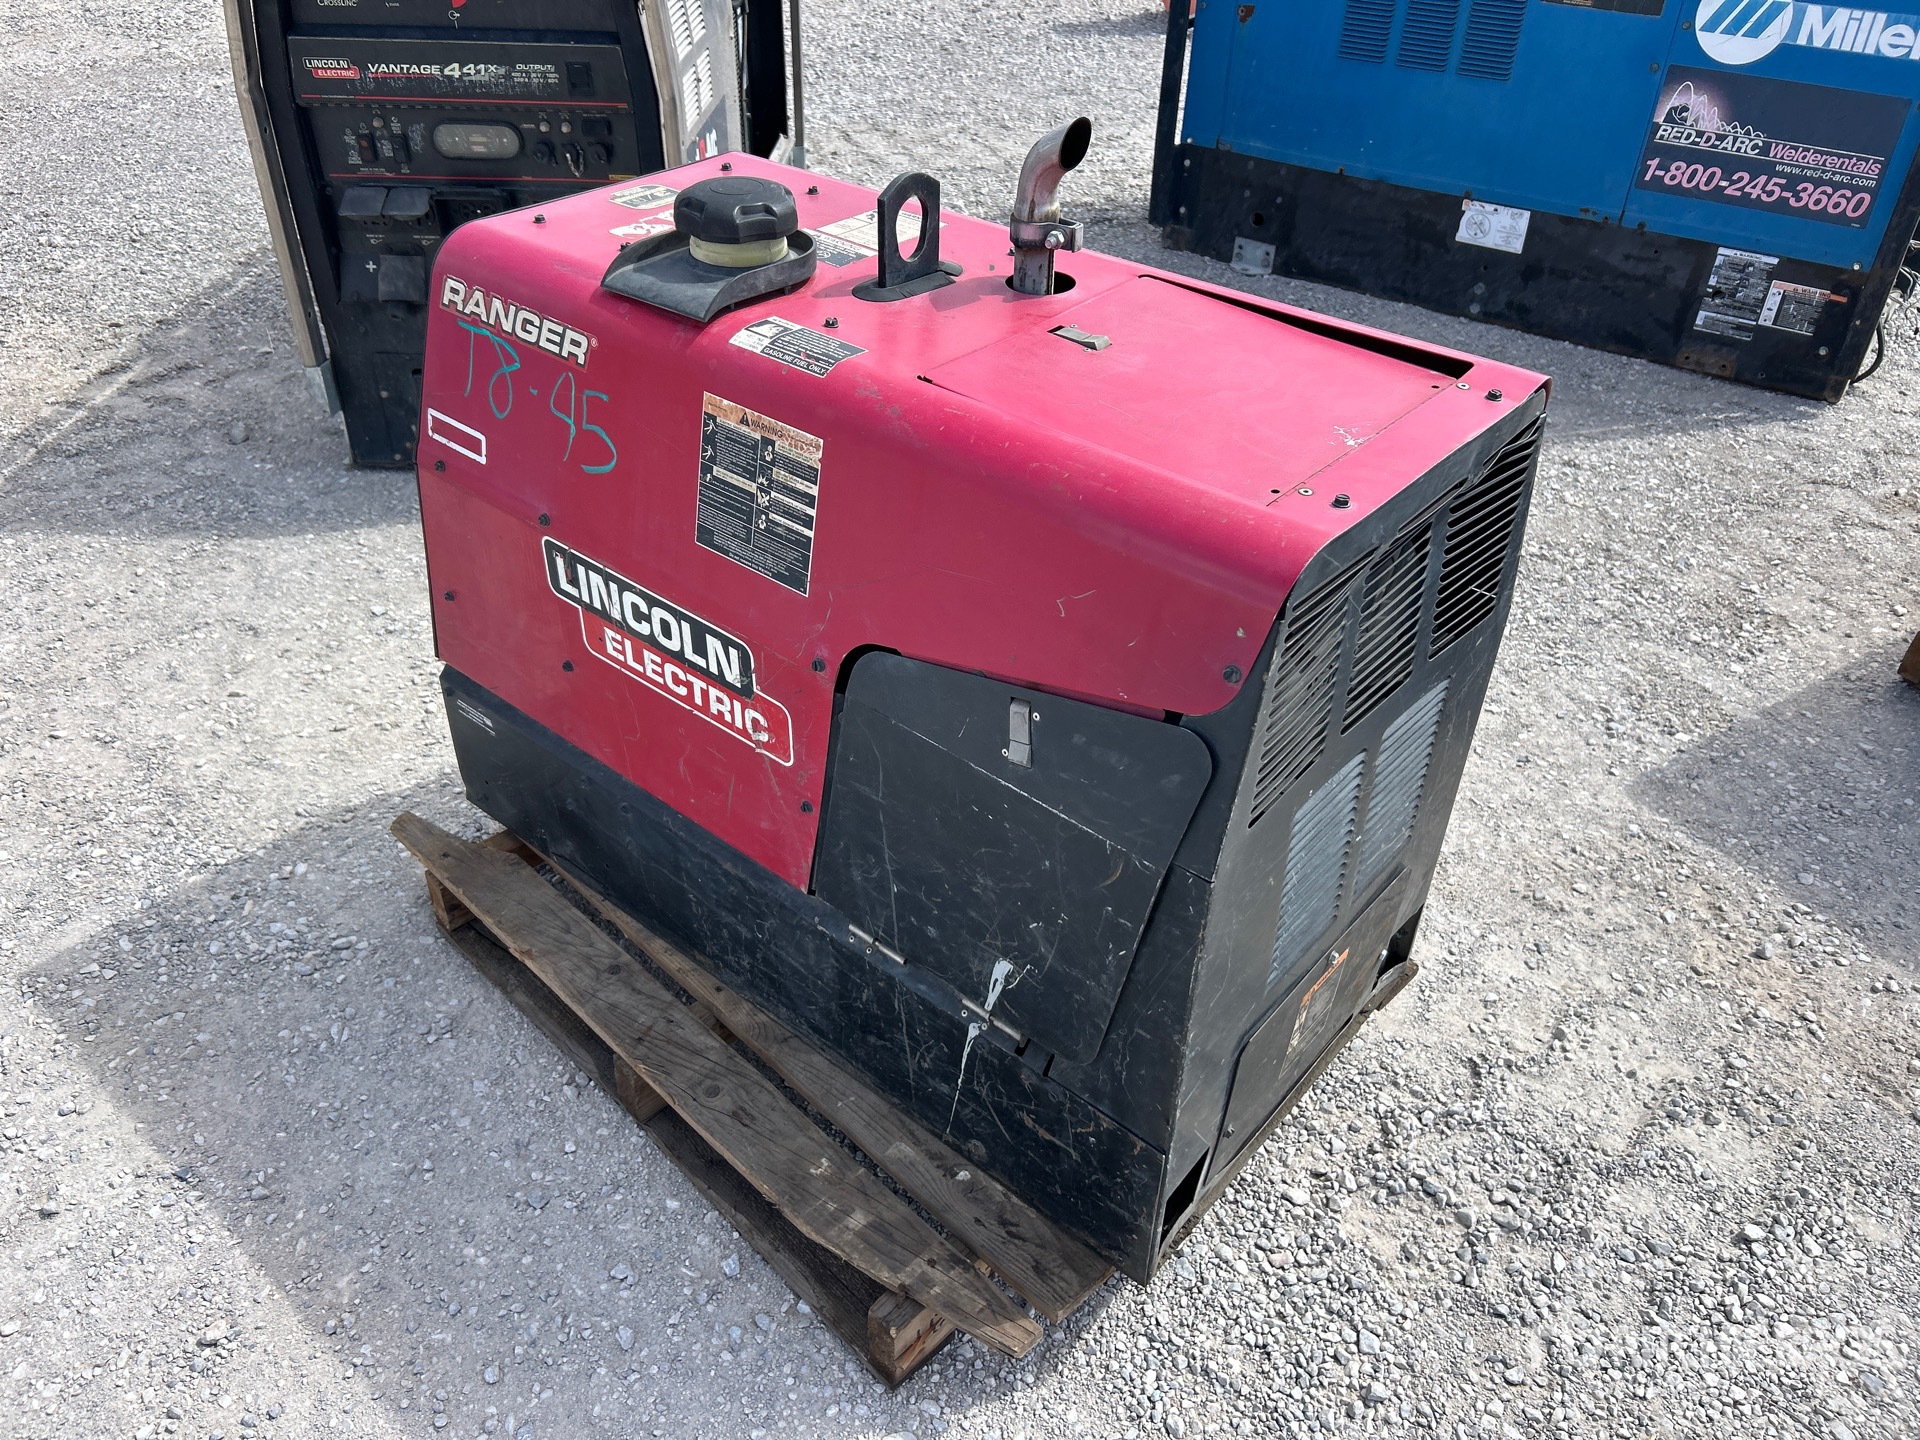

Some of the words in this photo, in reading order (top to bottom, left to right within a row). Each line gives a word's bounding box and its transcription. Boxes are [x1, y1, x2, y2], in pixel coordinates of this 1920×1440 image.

[305, 59, 348, 68] LINCOLN
[367, 63, 441, 74] VANTAGE
[1655, 125, 1763, 155] RED-D-ARC
[1768, 143, 1882, 176] Welderentals
[1644, 157, 1871, 218] 1-800-245-3660
[1775, 163, 1877, 188] www.red-d-arc.com
[442, 278, 590, 365] RANGER
[763, 347, 794, 363] GASOLINE
[793, 358, 809, 368] FUEL
[808, 363, 826, 374] ONLY
[750, 418, 784, 438] WARNING
[553, 554, 742, 688] LINCOLN
[604, 626, 769, 742] ELECTRIC
